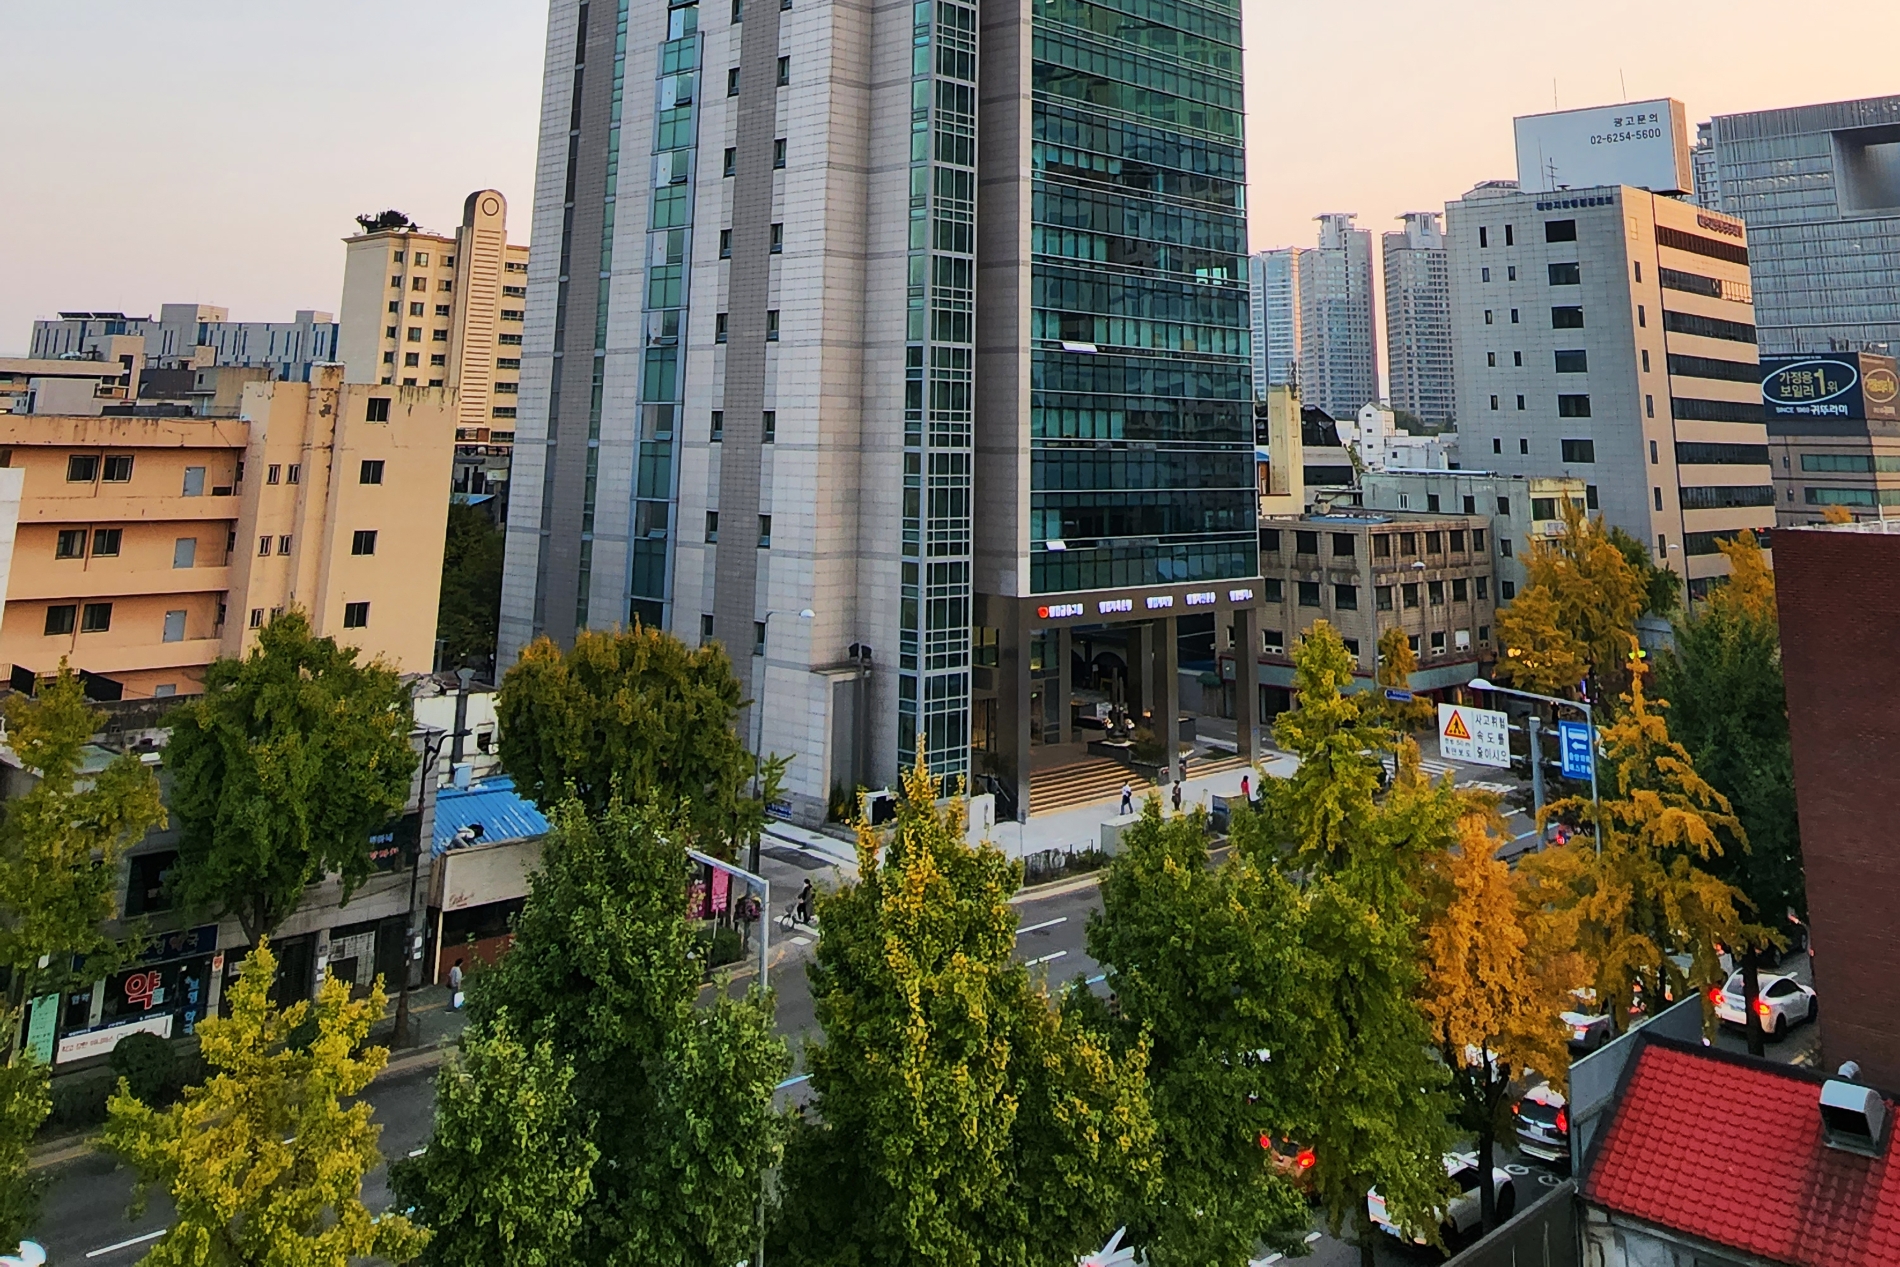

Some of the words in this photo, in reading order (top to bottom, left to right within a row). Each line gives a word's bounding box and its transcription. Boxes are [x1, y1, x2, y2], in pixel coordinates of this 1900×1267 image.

[1614, 113, 1658, 127] 광고문의
[1590, 128, 1661, 145] 02-6254-5600
[1779, 371, 1813, 384] 가정용
[1780, 385, 1815, 397] 보일러
[125, 970, 162, 1010] 약
